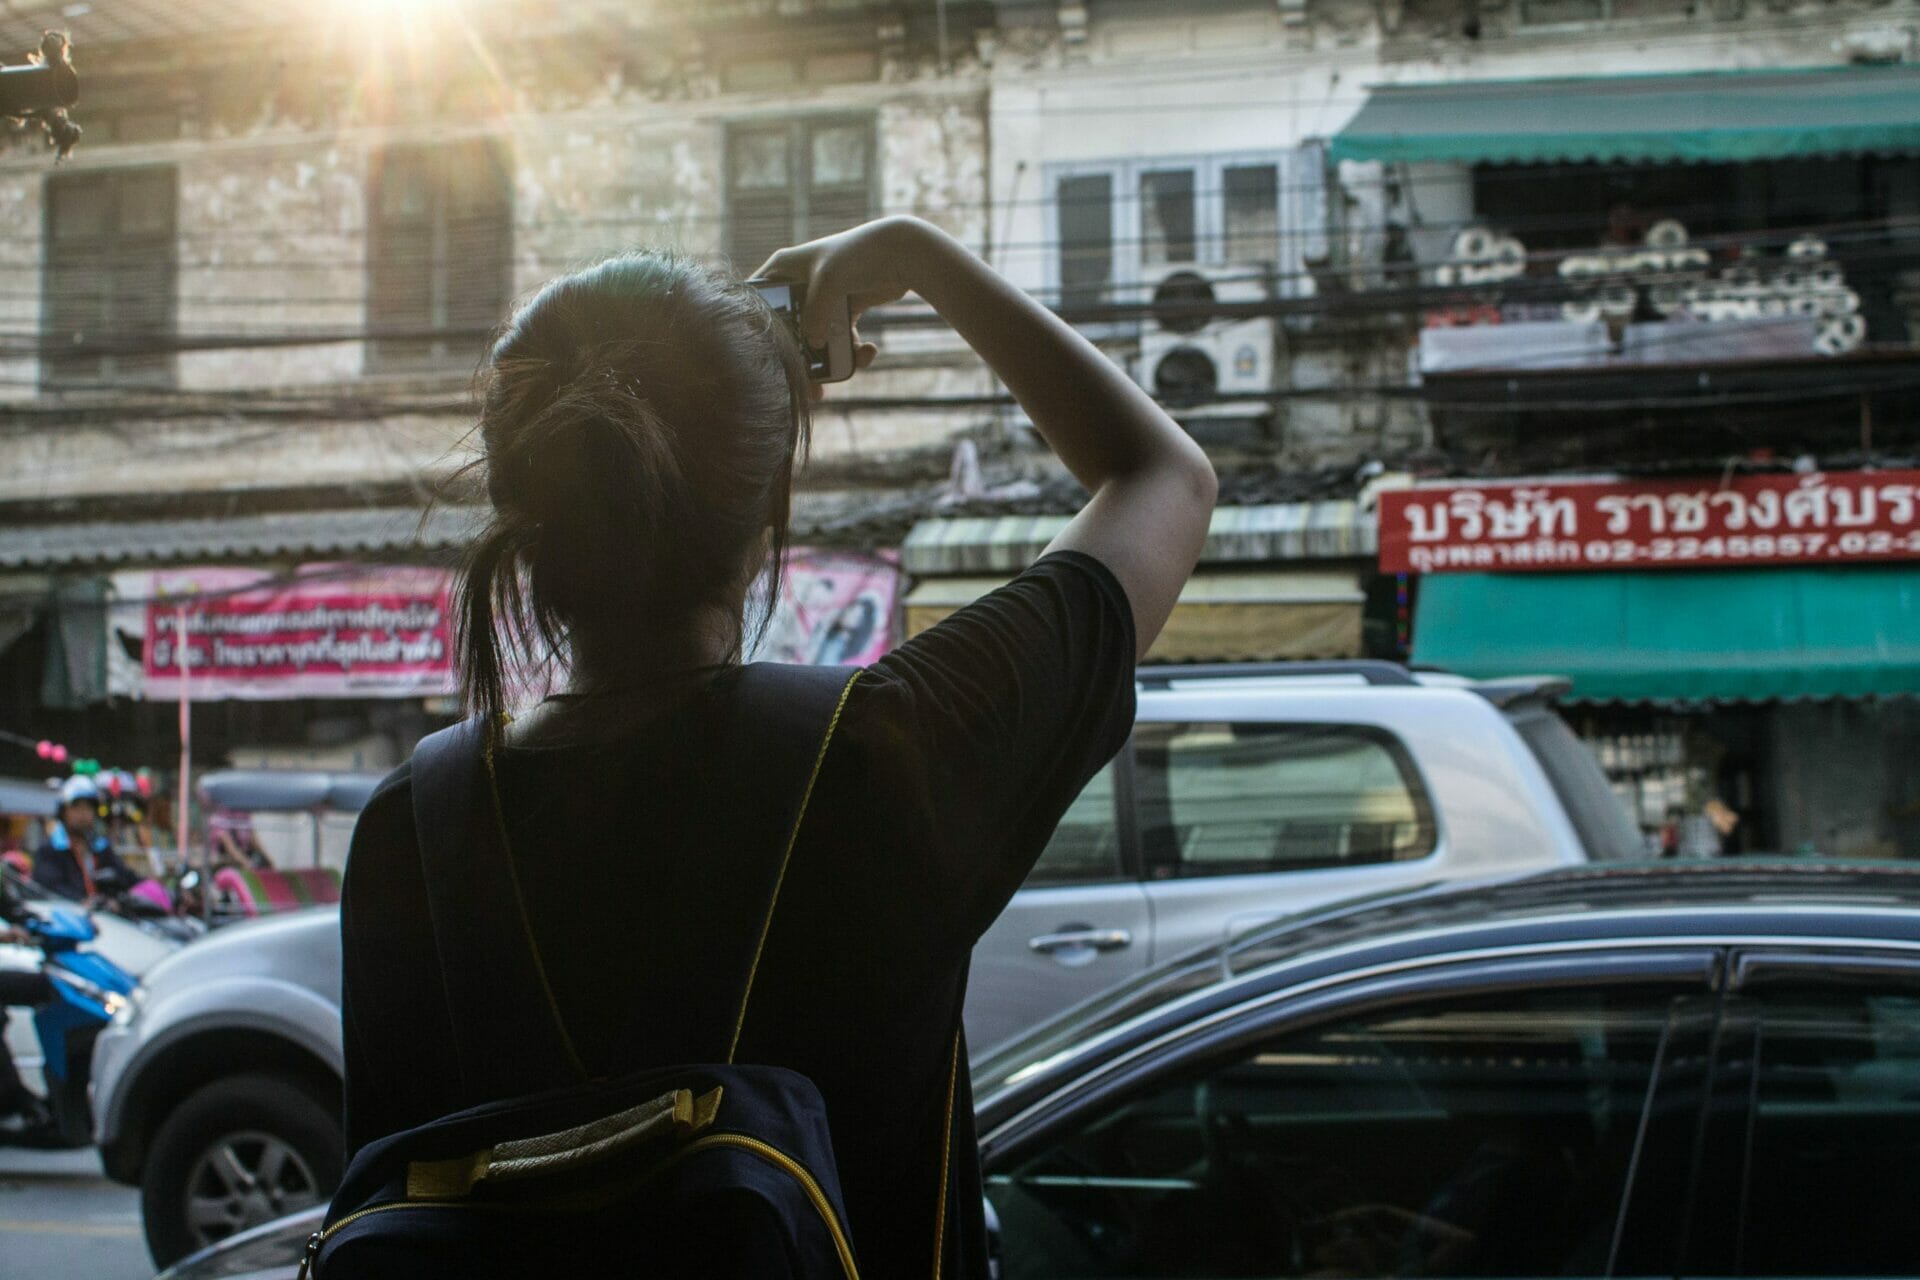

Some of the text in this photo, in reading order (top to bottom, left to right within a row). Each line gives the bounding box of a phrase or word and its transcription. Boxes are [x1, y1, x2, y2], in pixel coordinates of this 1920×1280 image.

[1404, 473, 1920, 541] บริษัท ราชวงศ์บร
